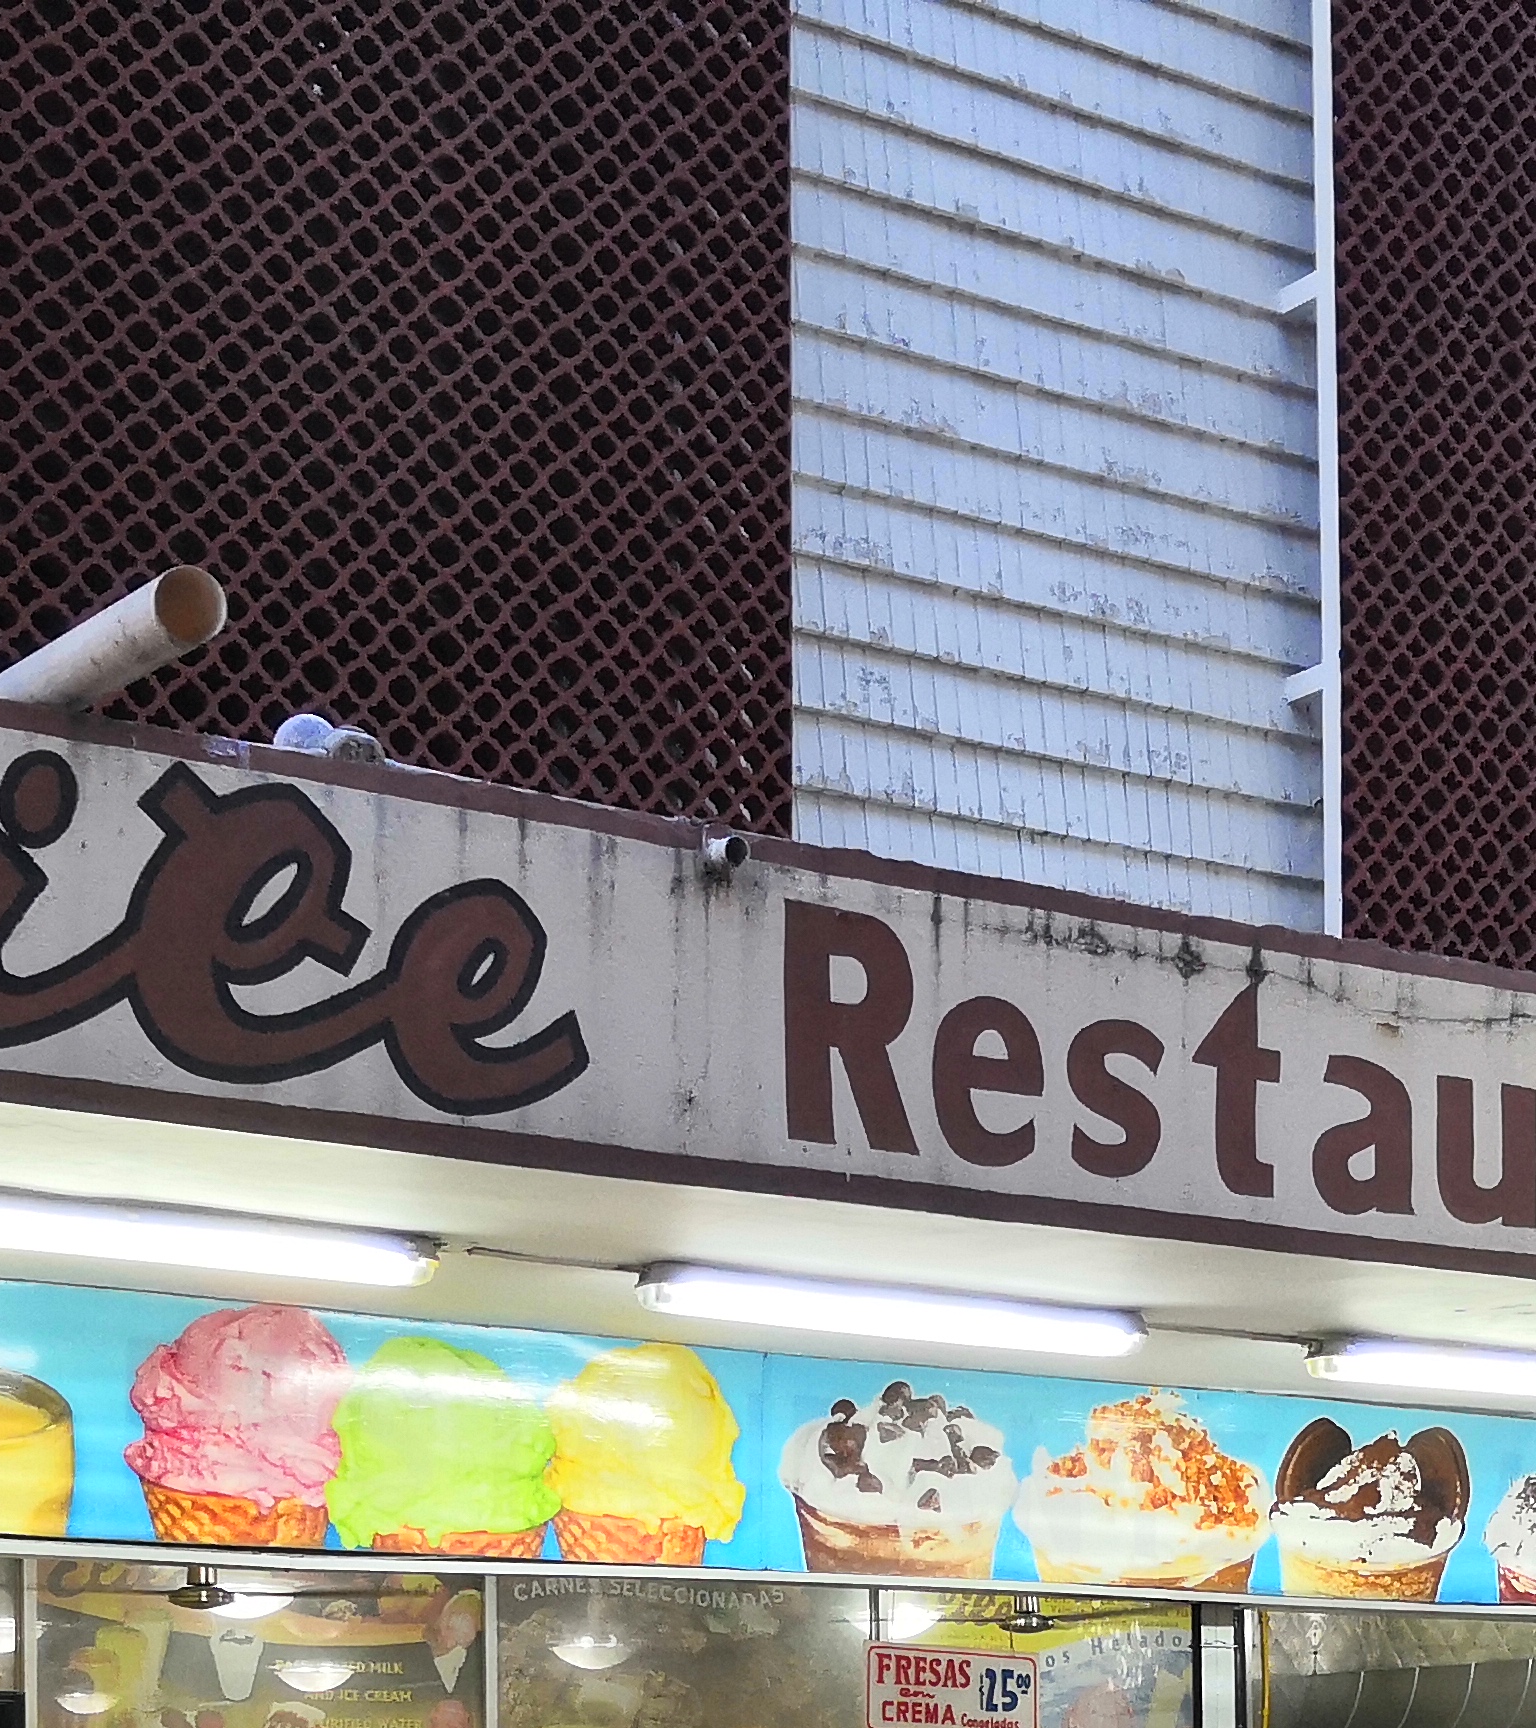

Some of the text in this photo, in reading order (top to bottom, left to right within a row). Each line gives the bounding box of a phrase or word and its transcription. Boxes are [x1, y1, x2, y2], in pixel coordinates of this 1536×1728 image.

[611, 1578, 785, 1609] SELECCIONADAS
[368, 1661, 404, 1675] MILK
[875, 1652, 972, 1689] FRESAS
[364, 1690, 413, 1703] CREAM
[899, 1687, 937, 1699] con
[881, 1700, 956, 1726] CREMA
